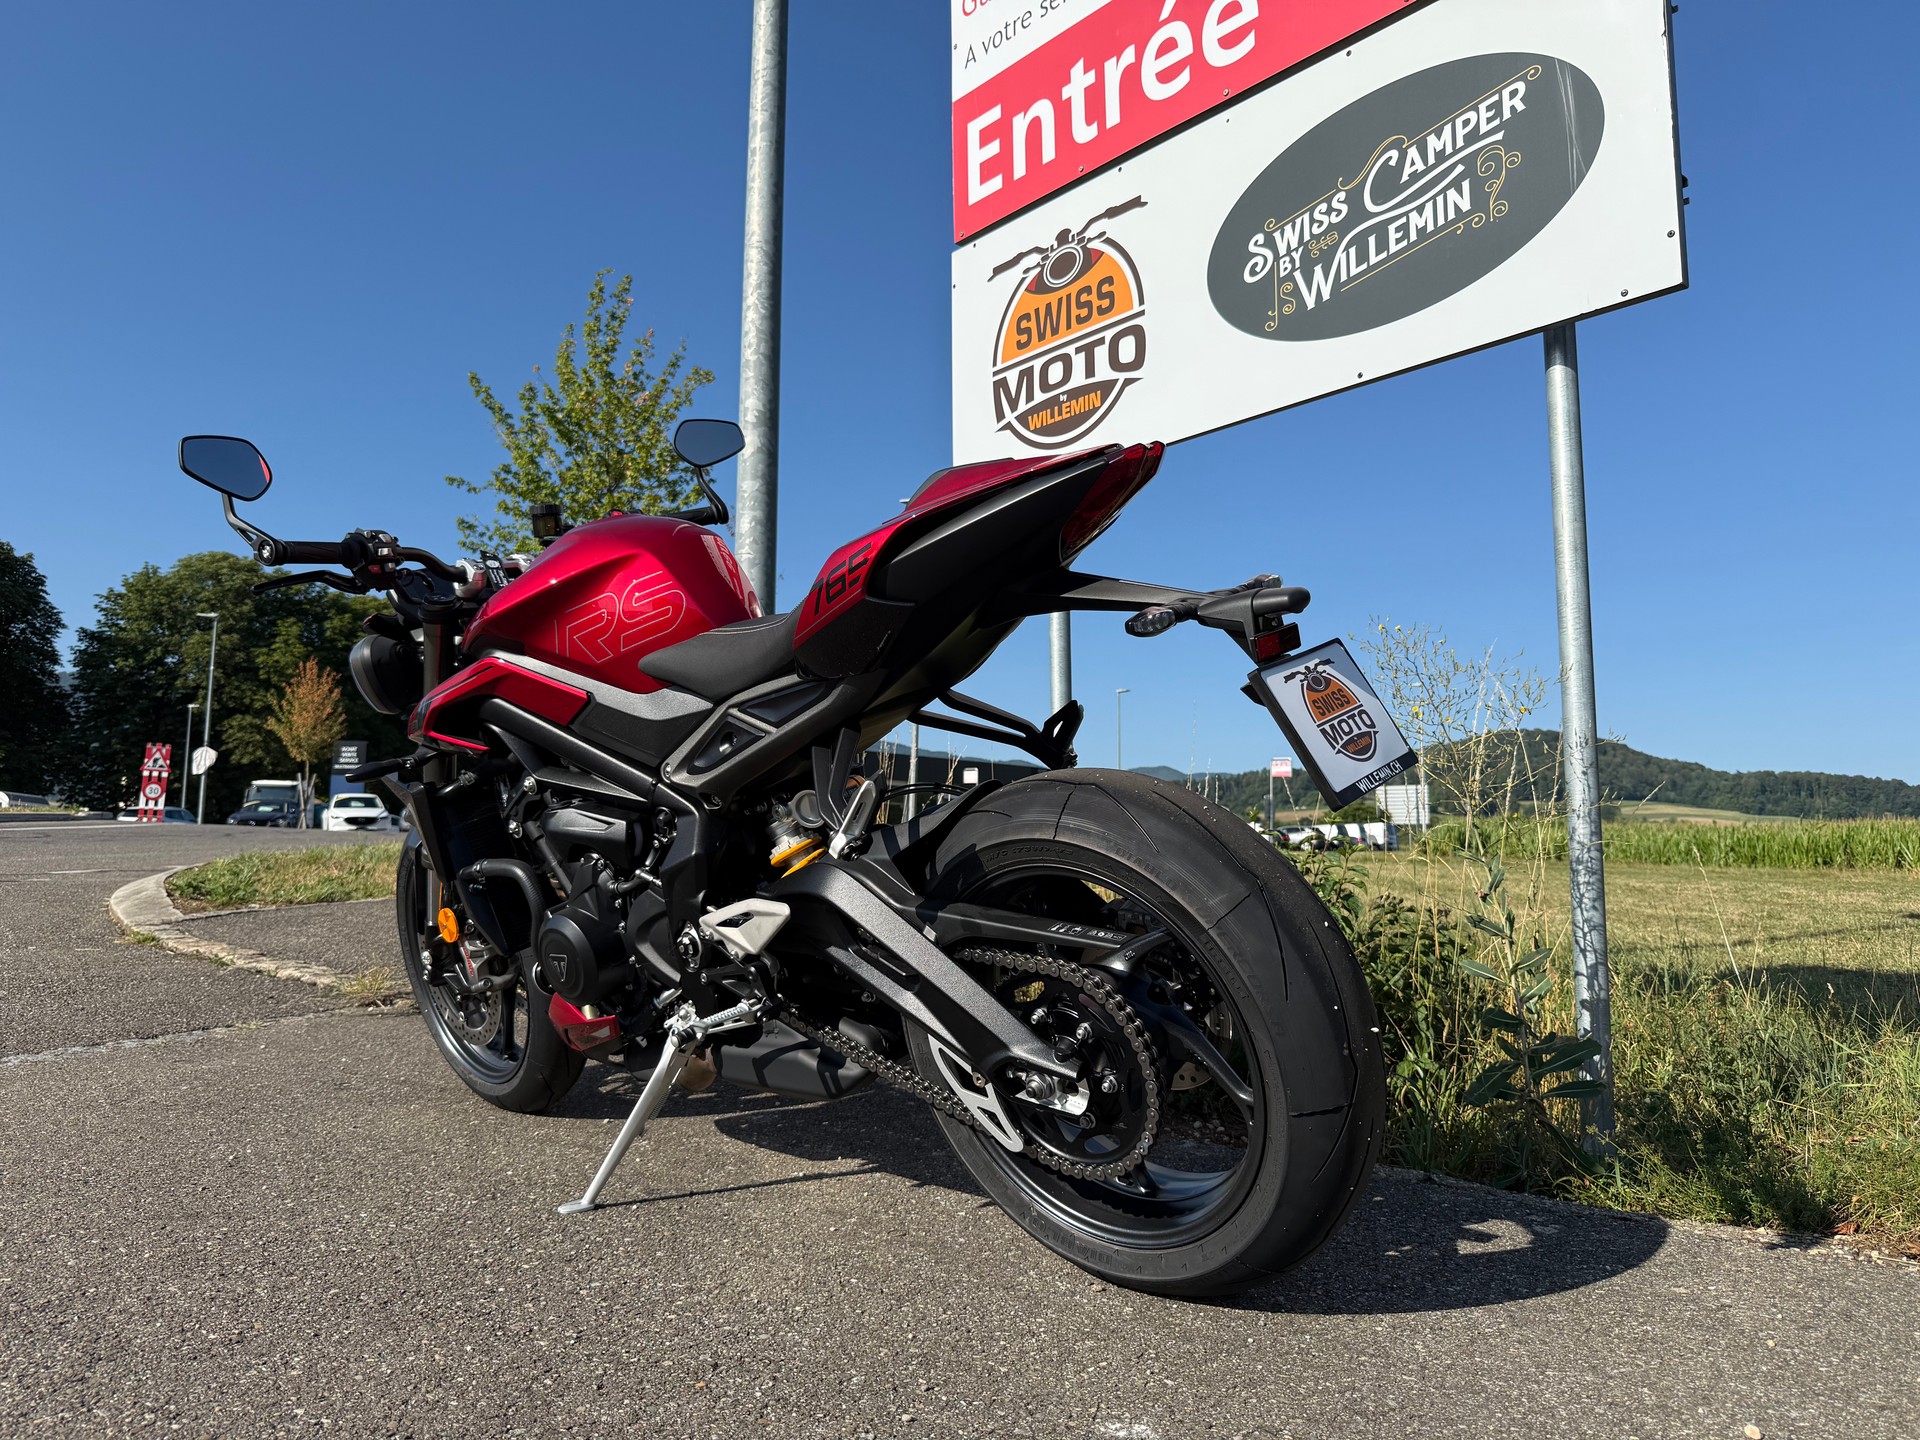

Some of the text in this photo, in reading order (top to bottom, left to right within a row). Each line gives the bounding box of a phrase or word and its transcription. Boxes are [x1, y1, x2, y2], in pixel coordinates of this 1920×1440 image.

[964, 44, 977, 69] A
[982, 10, 1033, 55] votre
[965, 0, 1259, 207] Entrée
[1243, 190, 1348, 283] SWISS
[1278, 245, 1305, 278] BY
[1293, 165, 1472, 311] WILLEMIN
[1015, 275, 1116, 351] SWISS
[992, 323, 1147, 425] MOTO
[1027, 390, 1103, 431] WILLEMIN
[809, 541, 873, 617] 765
[554, 570, 686, 664] RS
[1311, 688, 1351, 718] SWISS
[1319, 708, 1377, 752] MOTO
[1345, 735, 1372, 754] WILLEMIN
[147, 786, 160, 795] 30
[1356, 760, 1404, 794] WILLEMIN.CH
